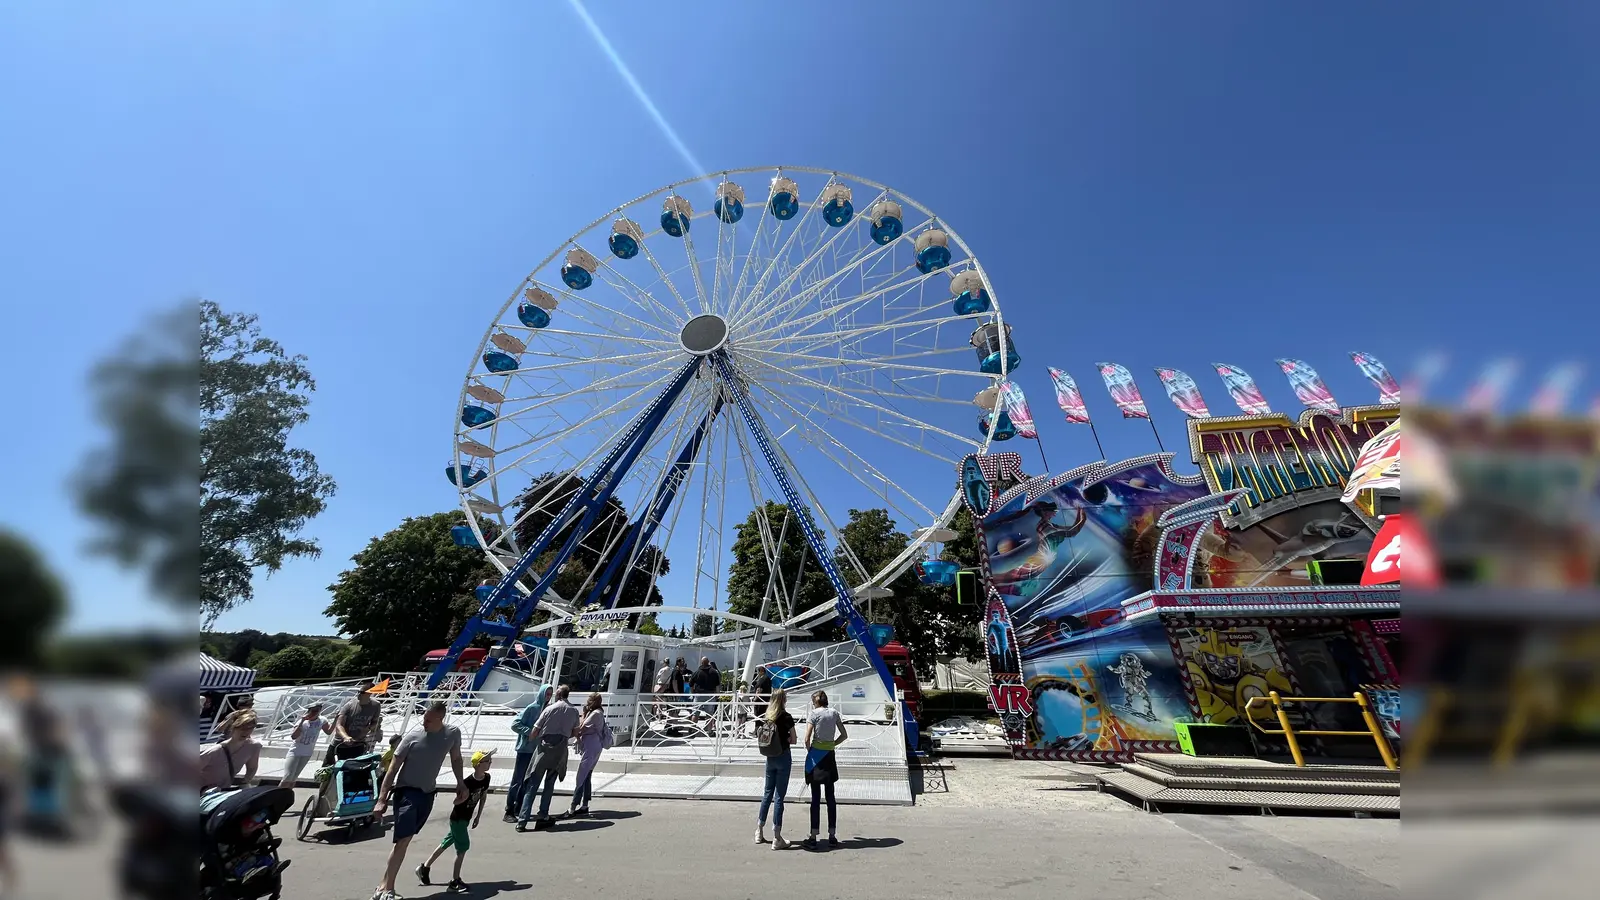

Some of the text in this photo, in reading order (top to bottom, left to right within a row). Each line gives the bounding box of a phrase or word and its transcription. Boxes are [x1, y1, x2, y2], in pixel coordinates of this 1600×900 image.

[976, 452, 1027, 483] VR
[1166, 541, 1188, 558] VR
[1162, 572, 1183, 590] VR
[1174, 595, 1194, 605] VR
[1200, 595, 1229, 605] PURE
[564, 612, 629, 623] GRMANNS
[988, 684, 1034, 718] VR
